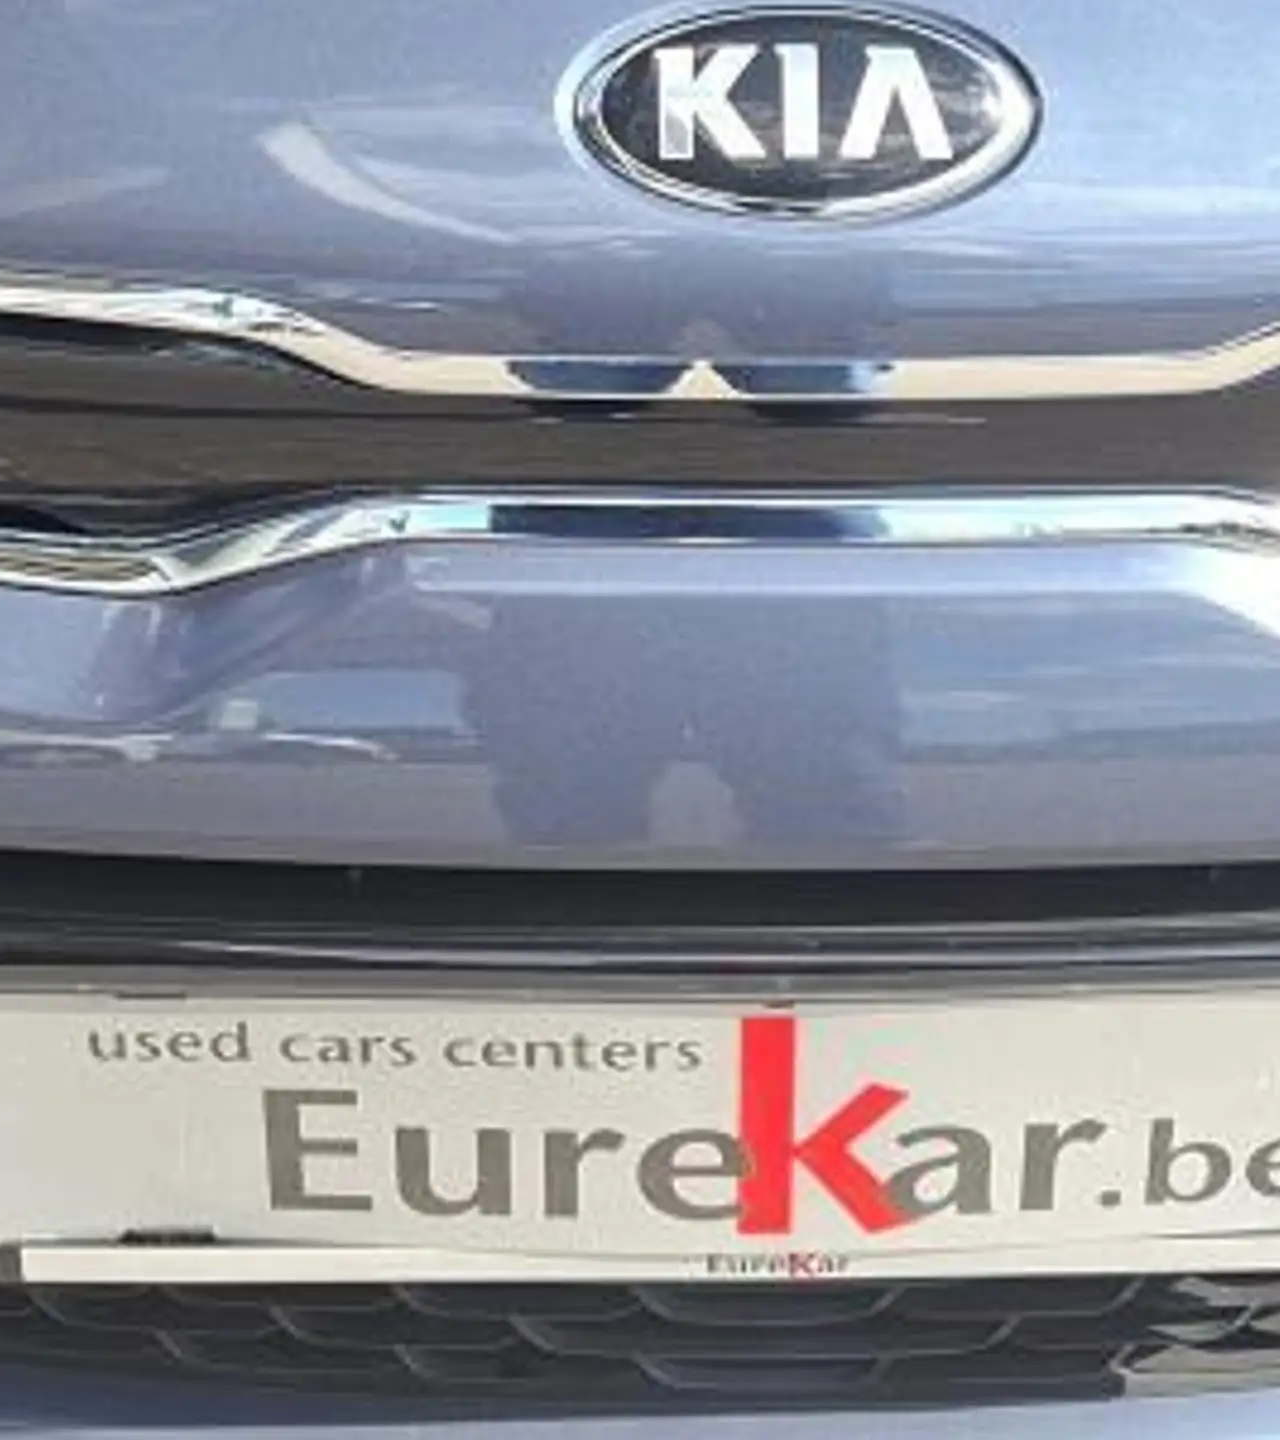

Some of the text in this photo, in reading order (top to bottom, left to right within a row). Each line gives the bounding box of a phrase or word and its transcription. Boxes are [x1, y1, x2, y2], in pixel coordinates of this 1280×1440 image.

[654, 43, 954, 161] KIA
[88, 1022, 703, 1072] used cars centers
